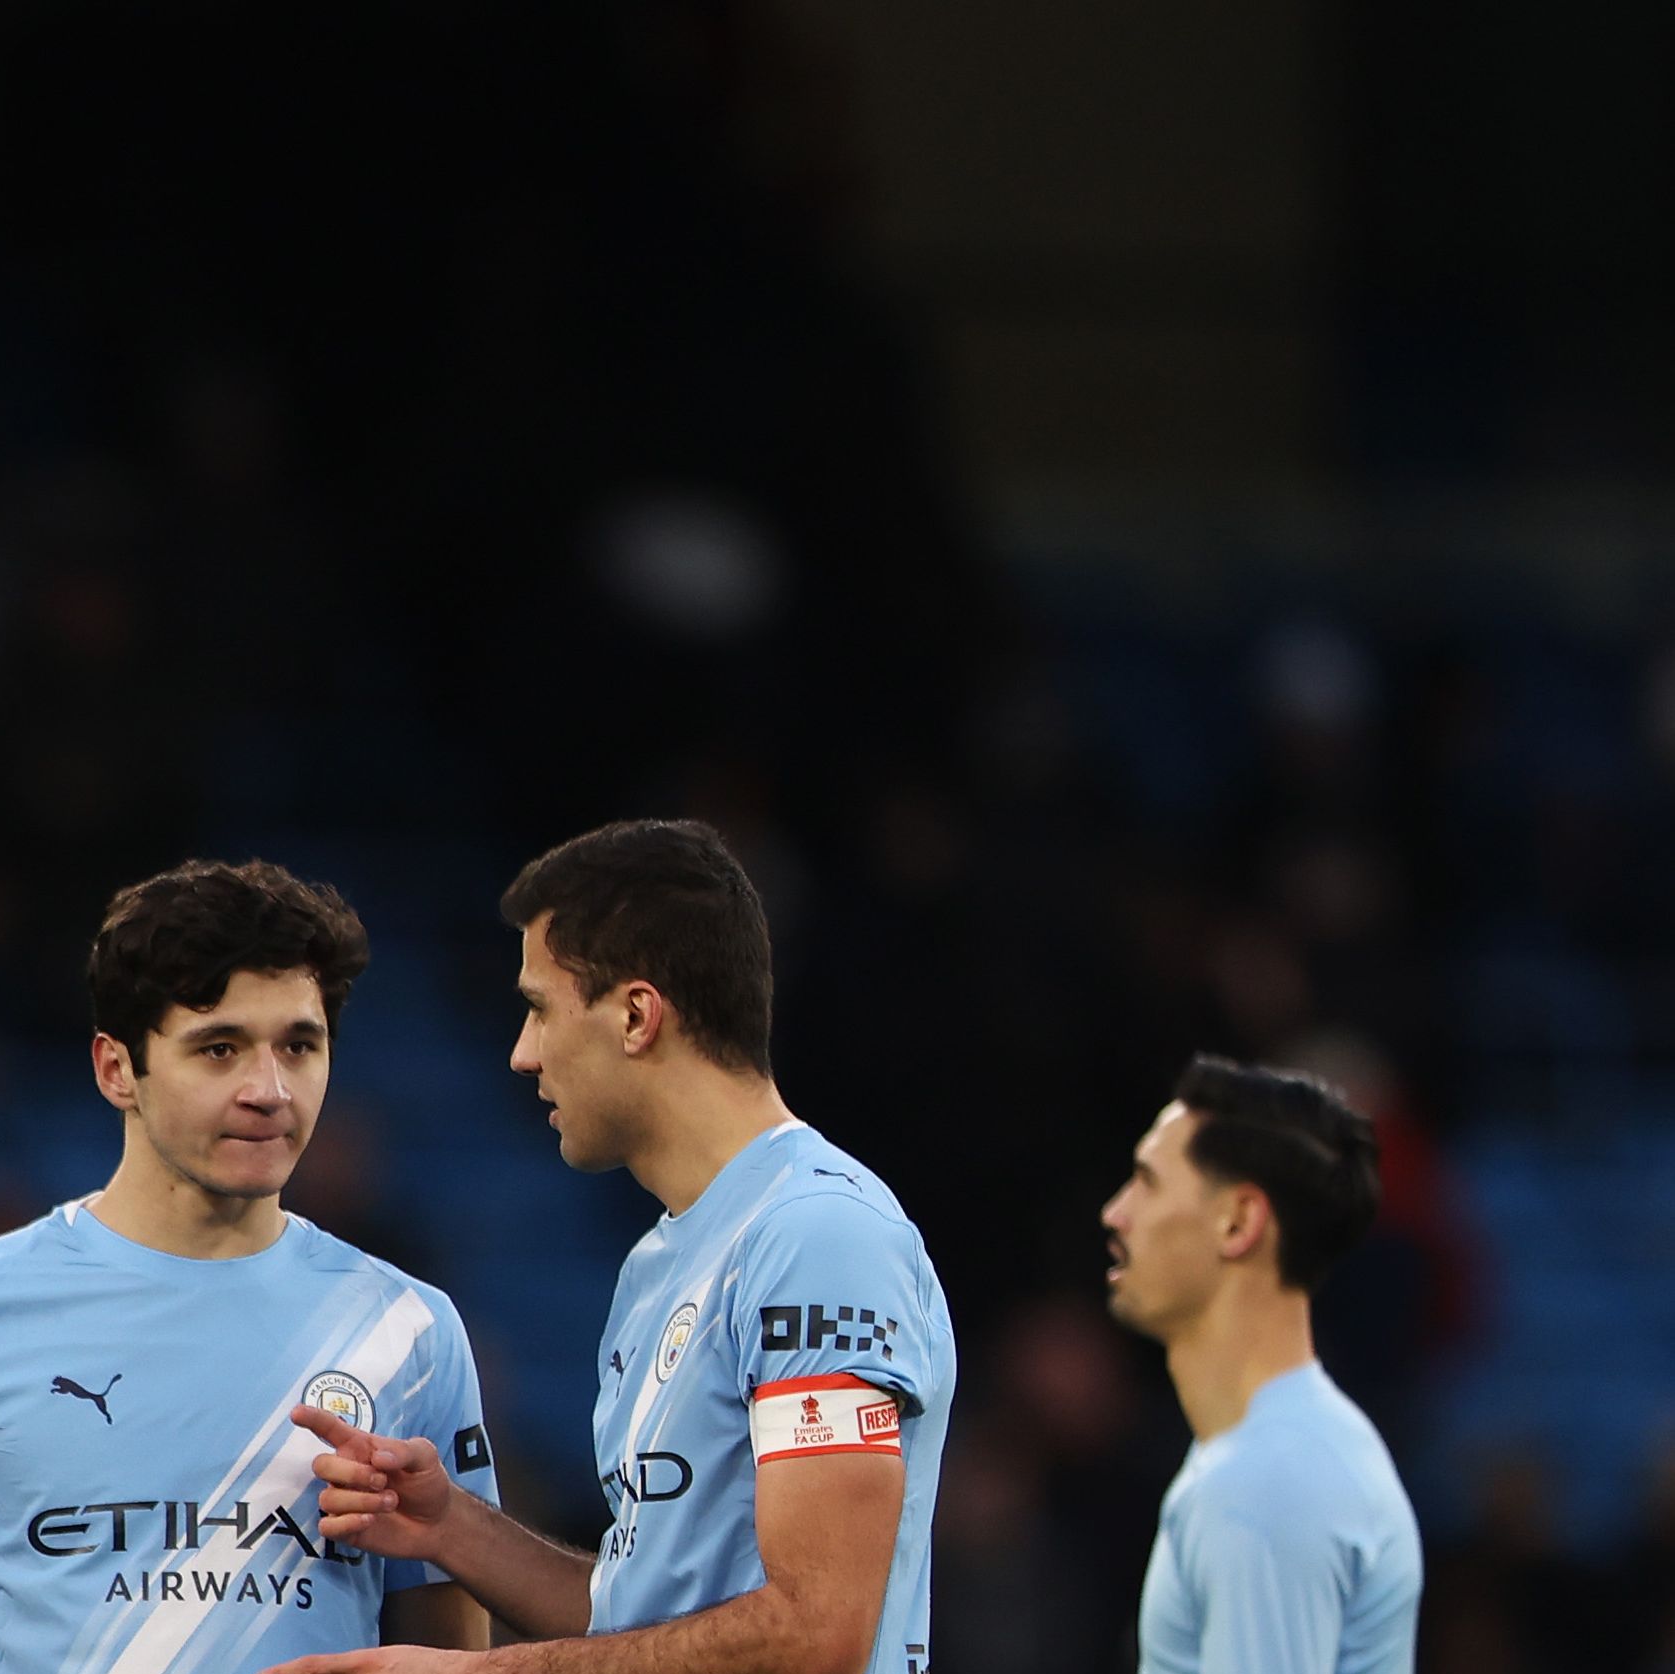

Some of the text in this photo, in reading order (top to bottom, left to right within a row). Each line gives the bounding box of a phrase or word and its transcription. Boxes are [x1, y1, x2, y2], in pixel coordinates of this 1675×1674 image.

[759, 1304, 898, 1362] OKX
[310, 1377, 368, 1406] MANCHESTER
[793, 1425, 833, 1436] Emirates
[794, 1433, 834, 1445] FA CUP
[105, 1571, 314, 1609] AIRWAYS
